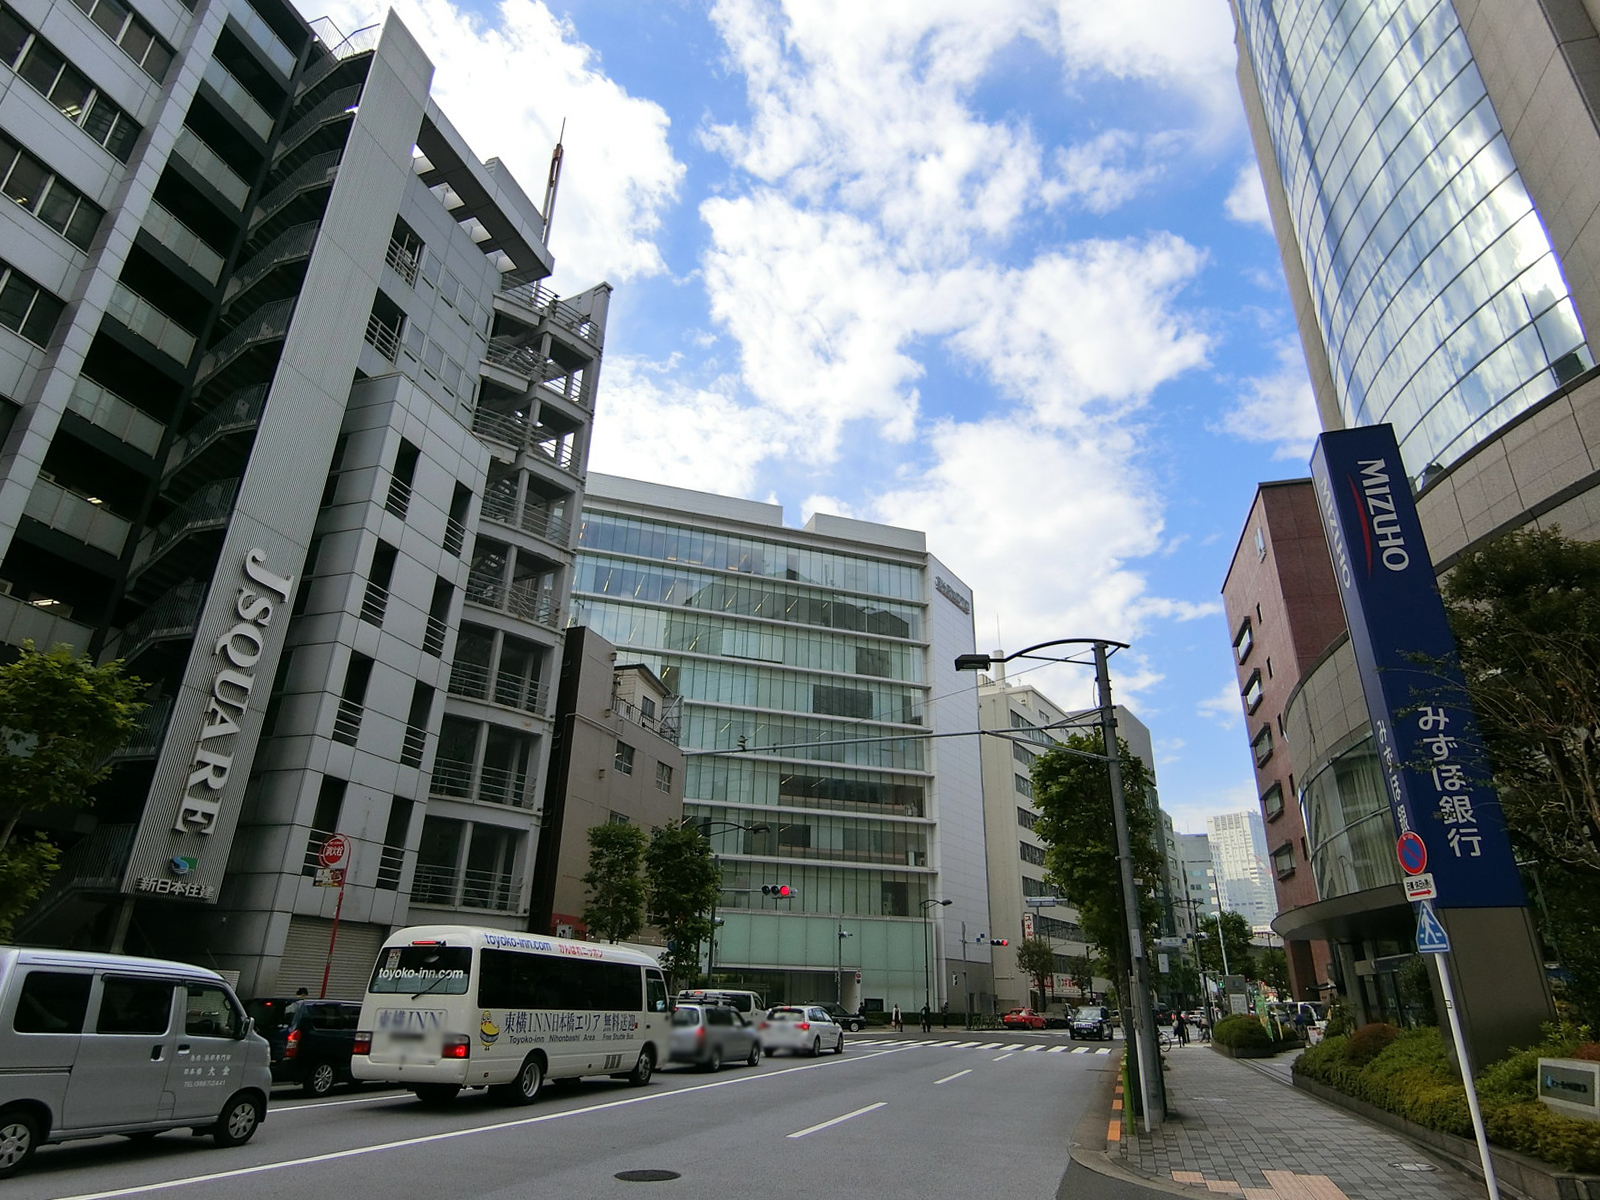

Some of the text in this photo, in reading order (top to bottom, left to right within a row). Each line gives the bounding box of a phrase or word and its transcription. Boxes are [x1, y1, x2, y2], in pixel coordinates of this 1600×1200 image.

[1320, 475, 1351, 589] MIZUHO
[1356, 457, 1410, 572] MIZUHO
[1377, 719, 1411, 835] みずほ銀
[1417, 706, 1482, 858] みずほ銀行
[137, 876, 216, 900] 新日本住建
[378, 967, 464, 981] toyoko-inn.com
[484, 932, 552, 952] toyoko-inn.com
[509, 1034, 545, 1045] Toyoko-inn
[549, 1033, 581, 1042] Nihonbashi
[583, 1033, 596, 1041] Area
